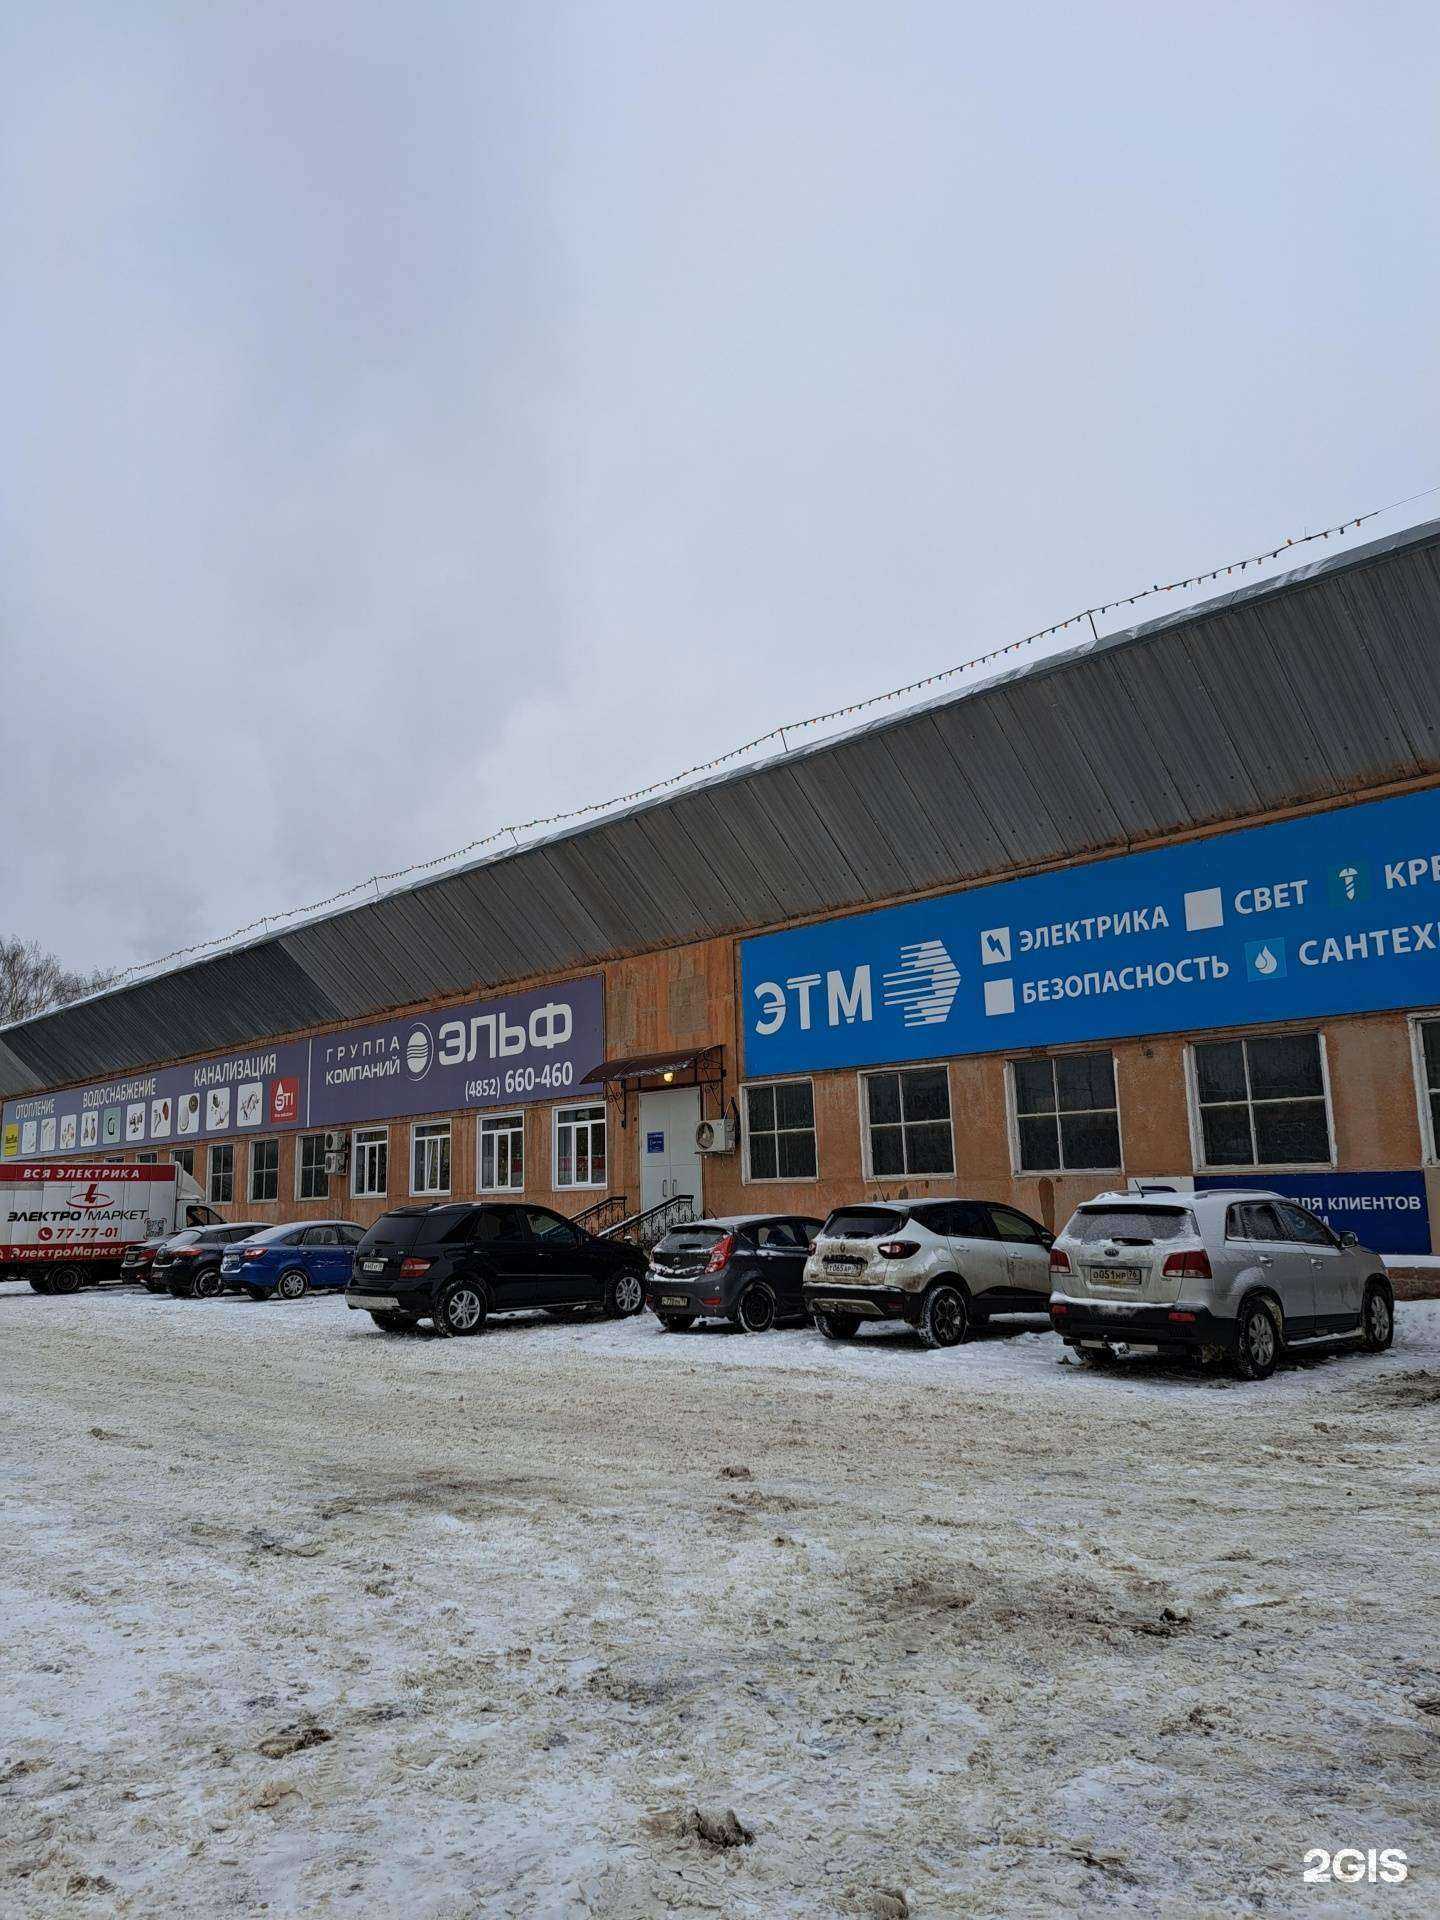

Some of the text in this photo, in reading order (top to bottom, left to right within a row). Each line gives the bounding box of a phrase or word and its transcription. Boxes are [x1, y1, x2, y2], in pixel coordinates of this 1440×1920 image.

[1018, 905, 1170, 952] ЭЛЕКТРИКА
[1234, 879, 1308, 915] СВЕТ
[1022, 921, 1440, 1004] БЕЗОПАСНОСТЬ САНТЕХ
[753, 964, 873, 1035] ЭТМ
[326, 1035, 400, 1063] ГРУППА
[438, 1002, 573, 1066] ЭЛЬФ
[193, 1053, 277, 1087] КАНАЛИЗАЦИЯ
[325, 1055, 401, 1086] КОМПАНИЙ
[465, 1061, 573, 1101] (4852) 660-460
[82, 1078, 157, 1108] ВОДОСНАБЖЕНИЕ
[276, 1091, 294, 1108] STI
[15, 1098, 55, 1119] ОТОПЛЕНИЕ
[23, 1168, 140, 1179] ВСЯ ЭЛЕКТРИКА
[7, 1209, 149, 1222] ЭЛЕКТРО МАРКЕТ
[1327, 1196, 1421, 1211] КЛИЕНТОВ
[56, 1227, 119, 1239] 77-77-01
